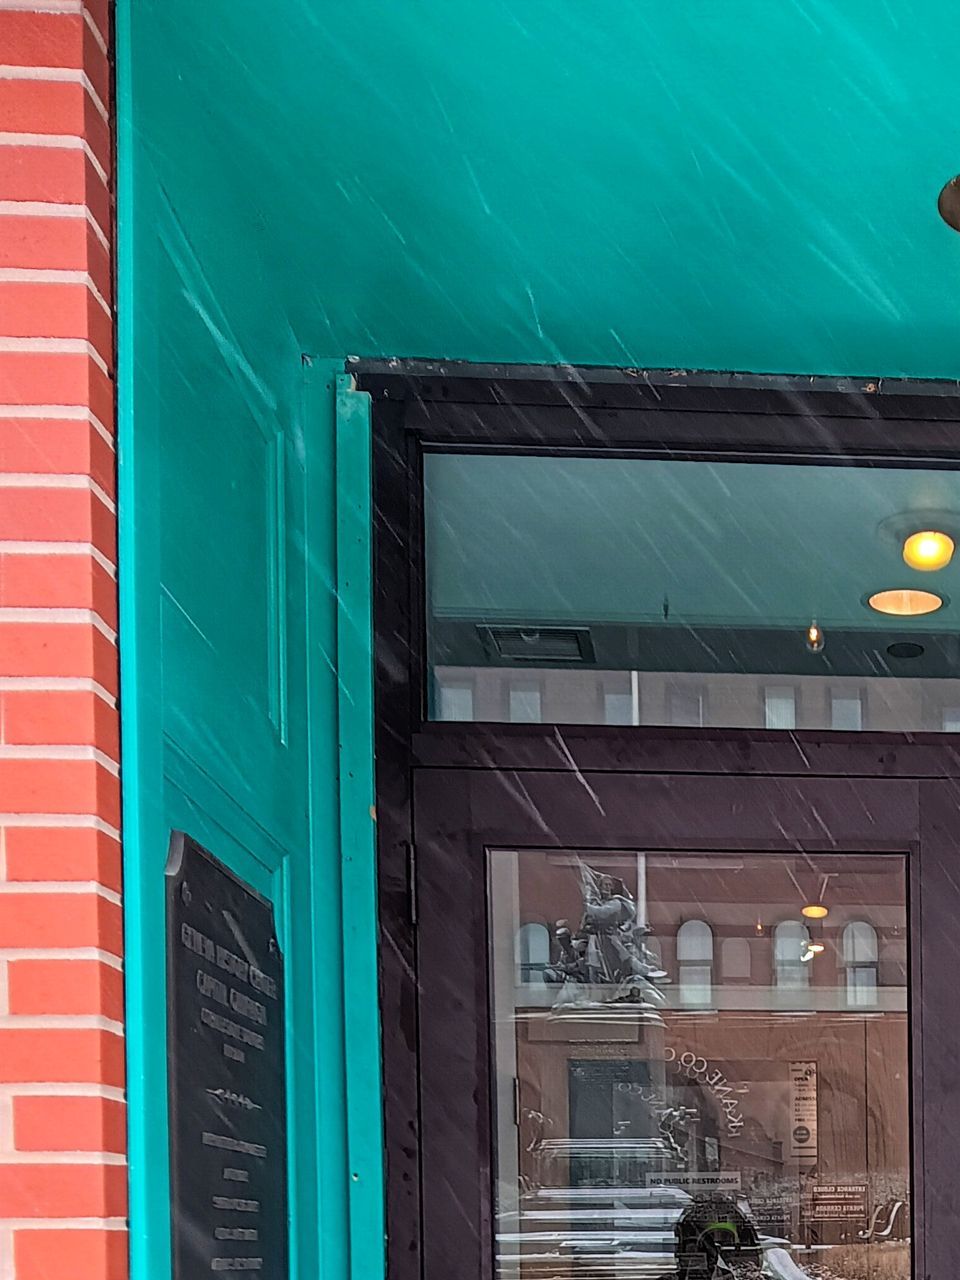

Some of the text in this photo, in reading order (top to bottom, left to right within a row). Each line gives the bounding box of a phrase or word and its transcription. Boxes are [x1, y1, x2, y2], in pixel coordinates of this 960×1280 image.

[650, 1177, 738, 1185] NO PUBLIC RESTROOMS
